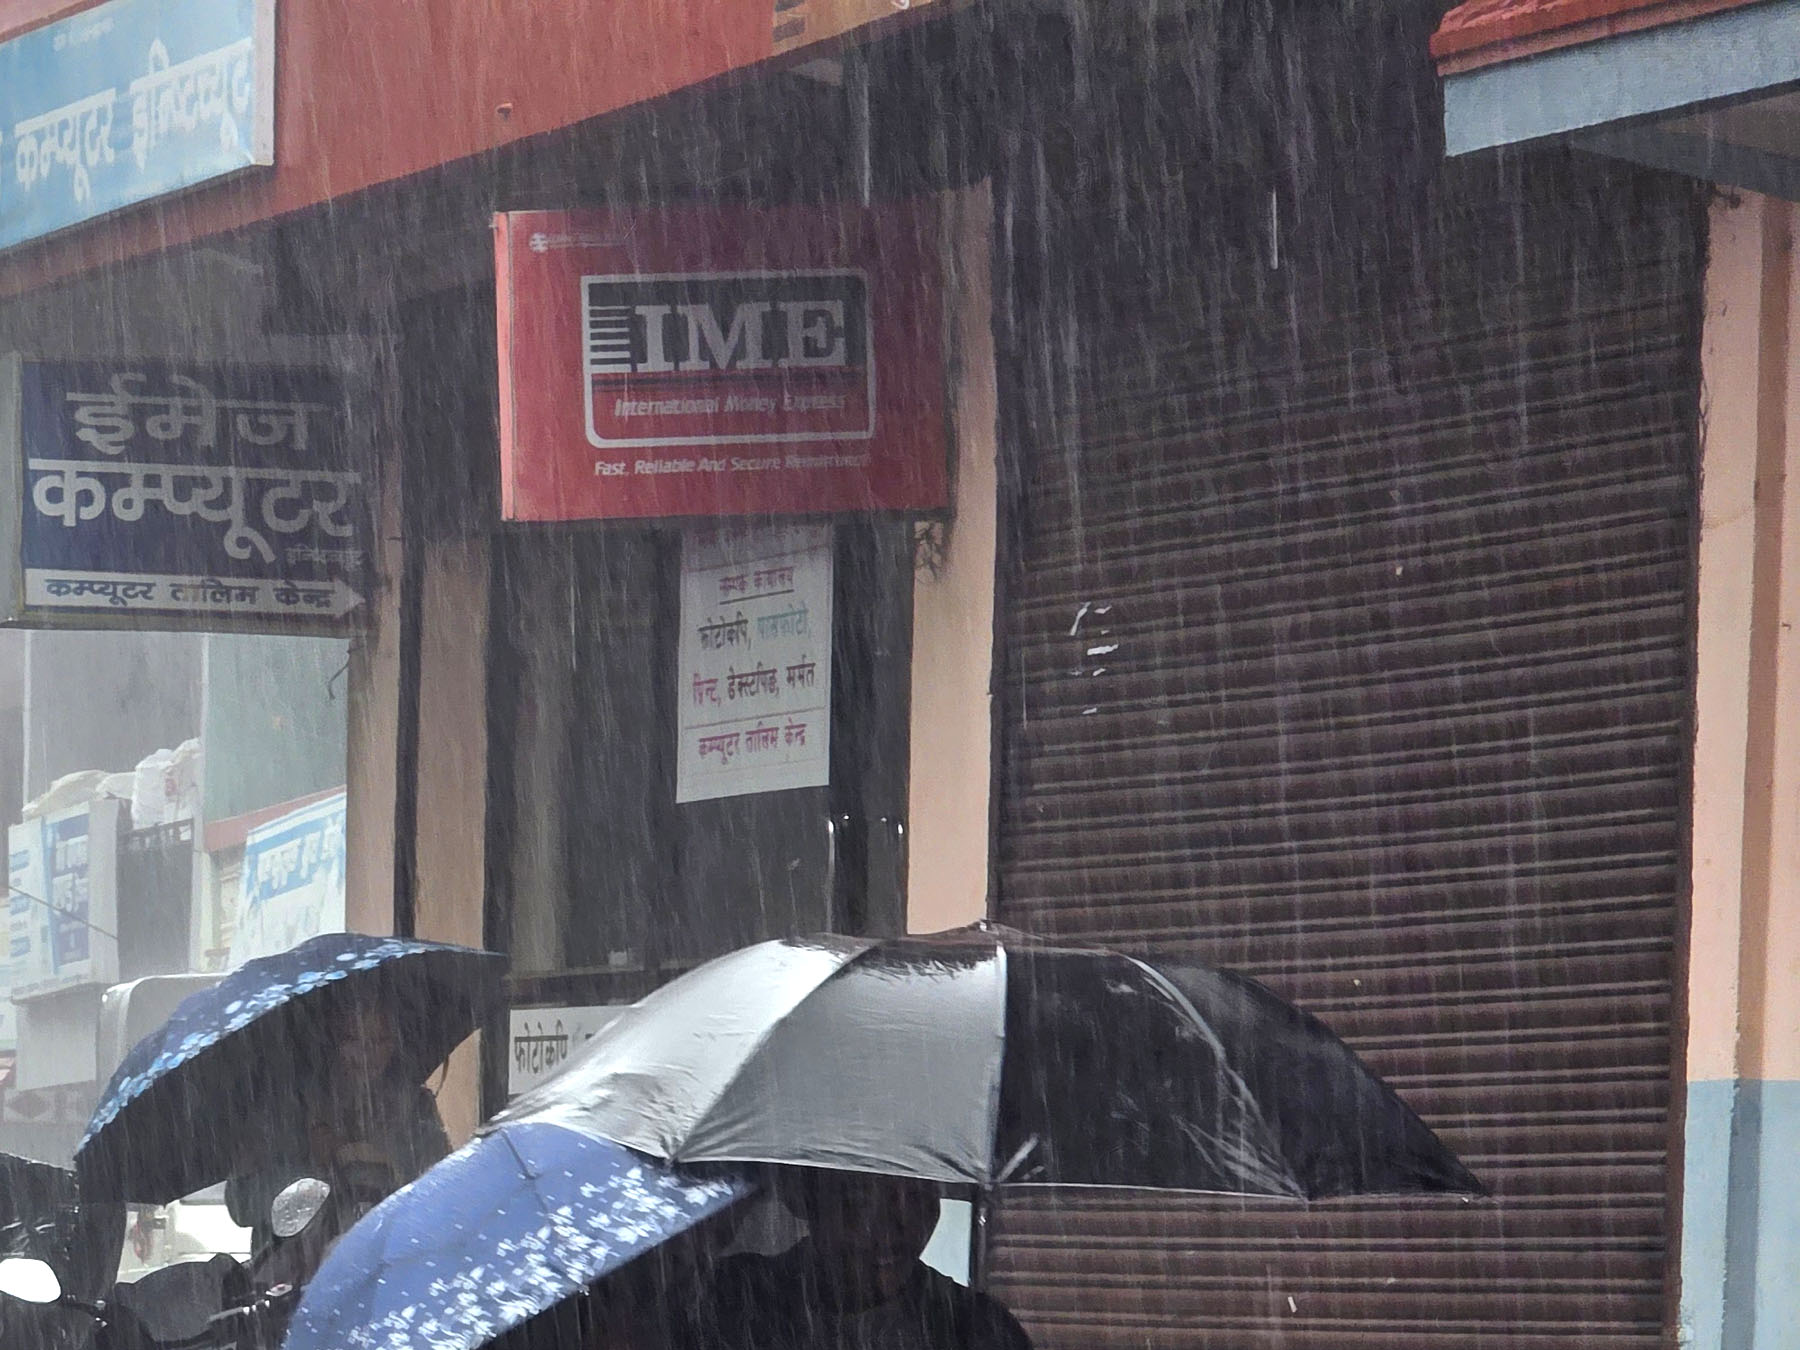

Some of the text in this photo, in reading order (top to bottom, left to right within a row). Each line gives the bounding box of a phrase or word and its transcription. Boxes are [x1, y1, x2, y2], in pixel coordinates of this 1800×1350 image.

[635, 300, 847, 373] IME
[66, 372, 330, 455] ईमेज
[634, 458, 696, 475] Reliable
[699, 457, 727, 473] And
[28, 458, 361, 563] कम्प्यूटर
[45, 578, 158, 607] कम्प्यूटर
